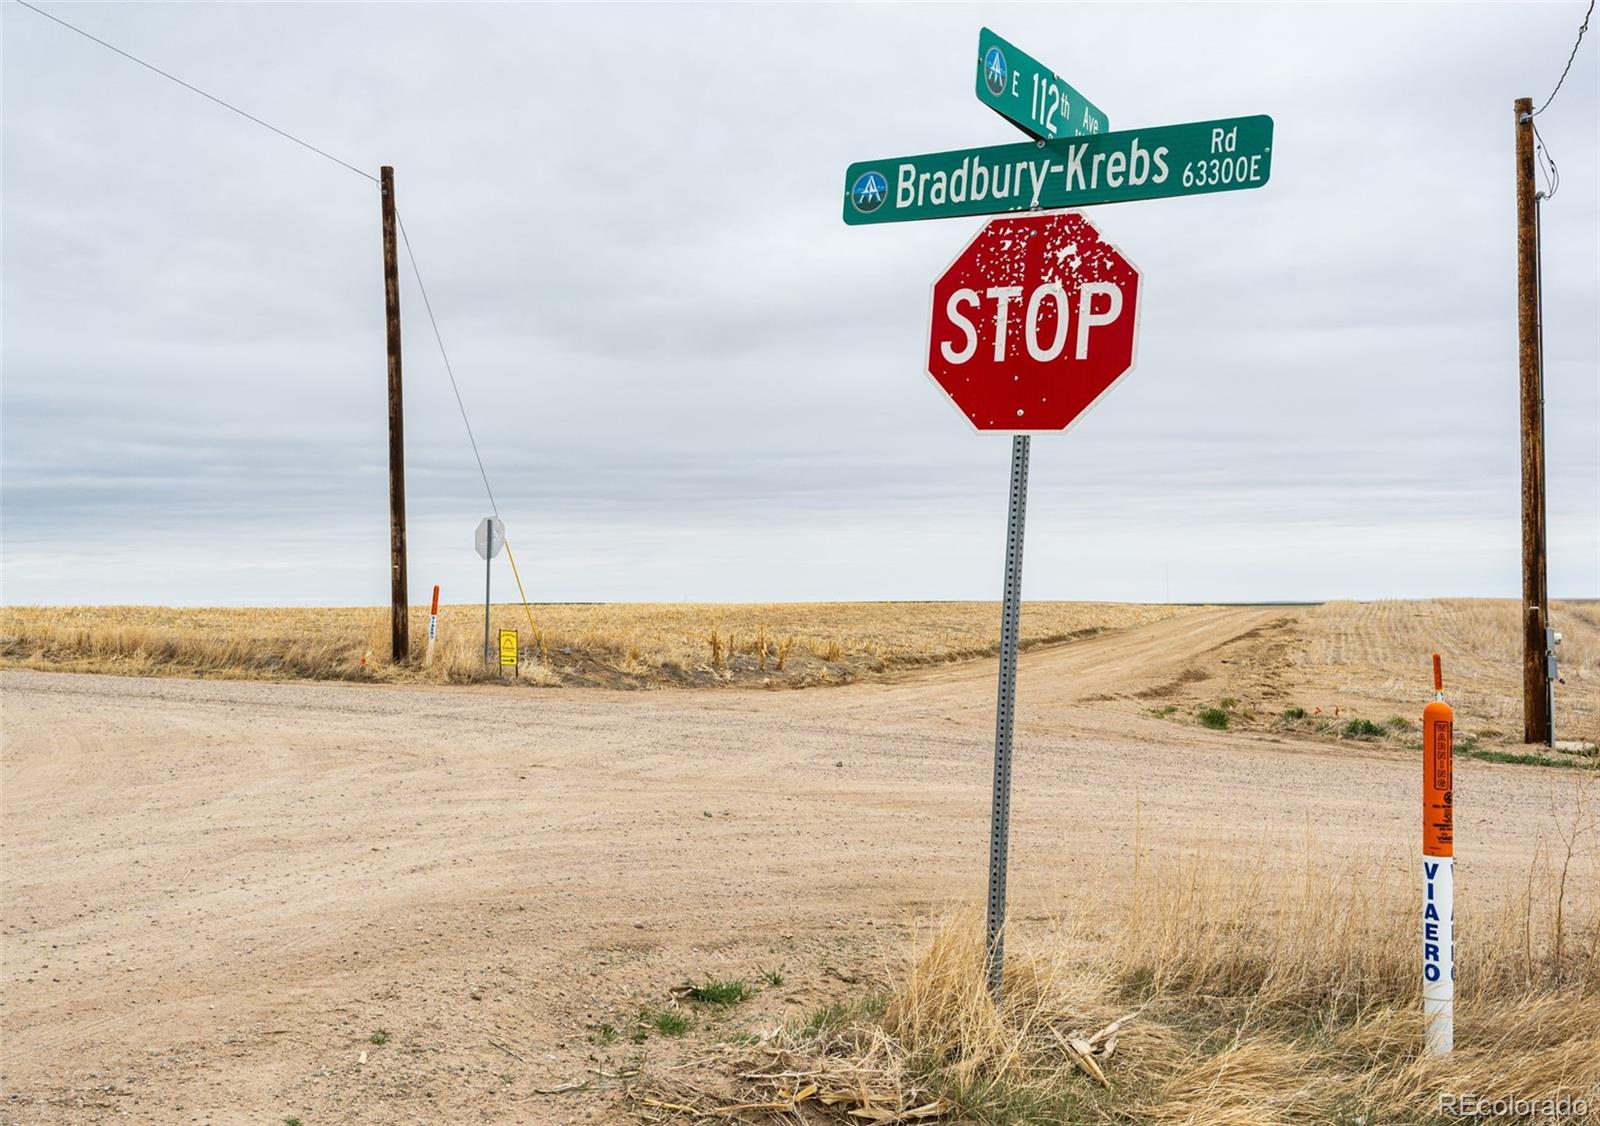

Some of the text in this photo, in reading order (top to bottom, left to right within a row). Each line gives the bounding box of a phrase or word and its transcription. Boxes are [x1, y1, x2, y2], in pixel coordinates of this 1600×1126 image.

[1012, 70, 1099, 134] E 112th Ave
[896, 127, 1237, 208] Bradbury-Krebs Rd
[1182, 155, 1261, 188] 63300E
[941, 282, 1123, 364] STOP
[1424, 862, 1440, 982] VIAERO
